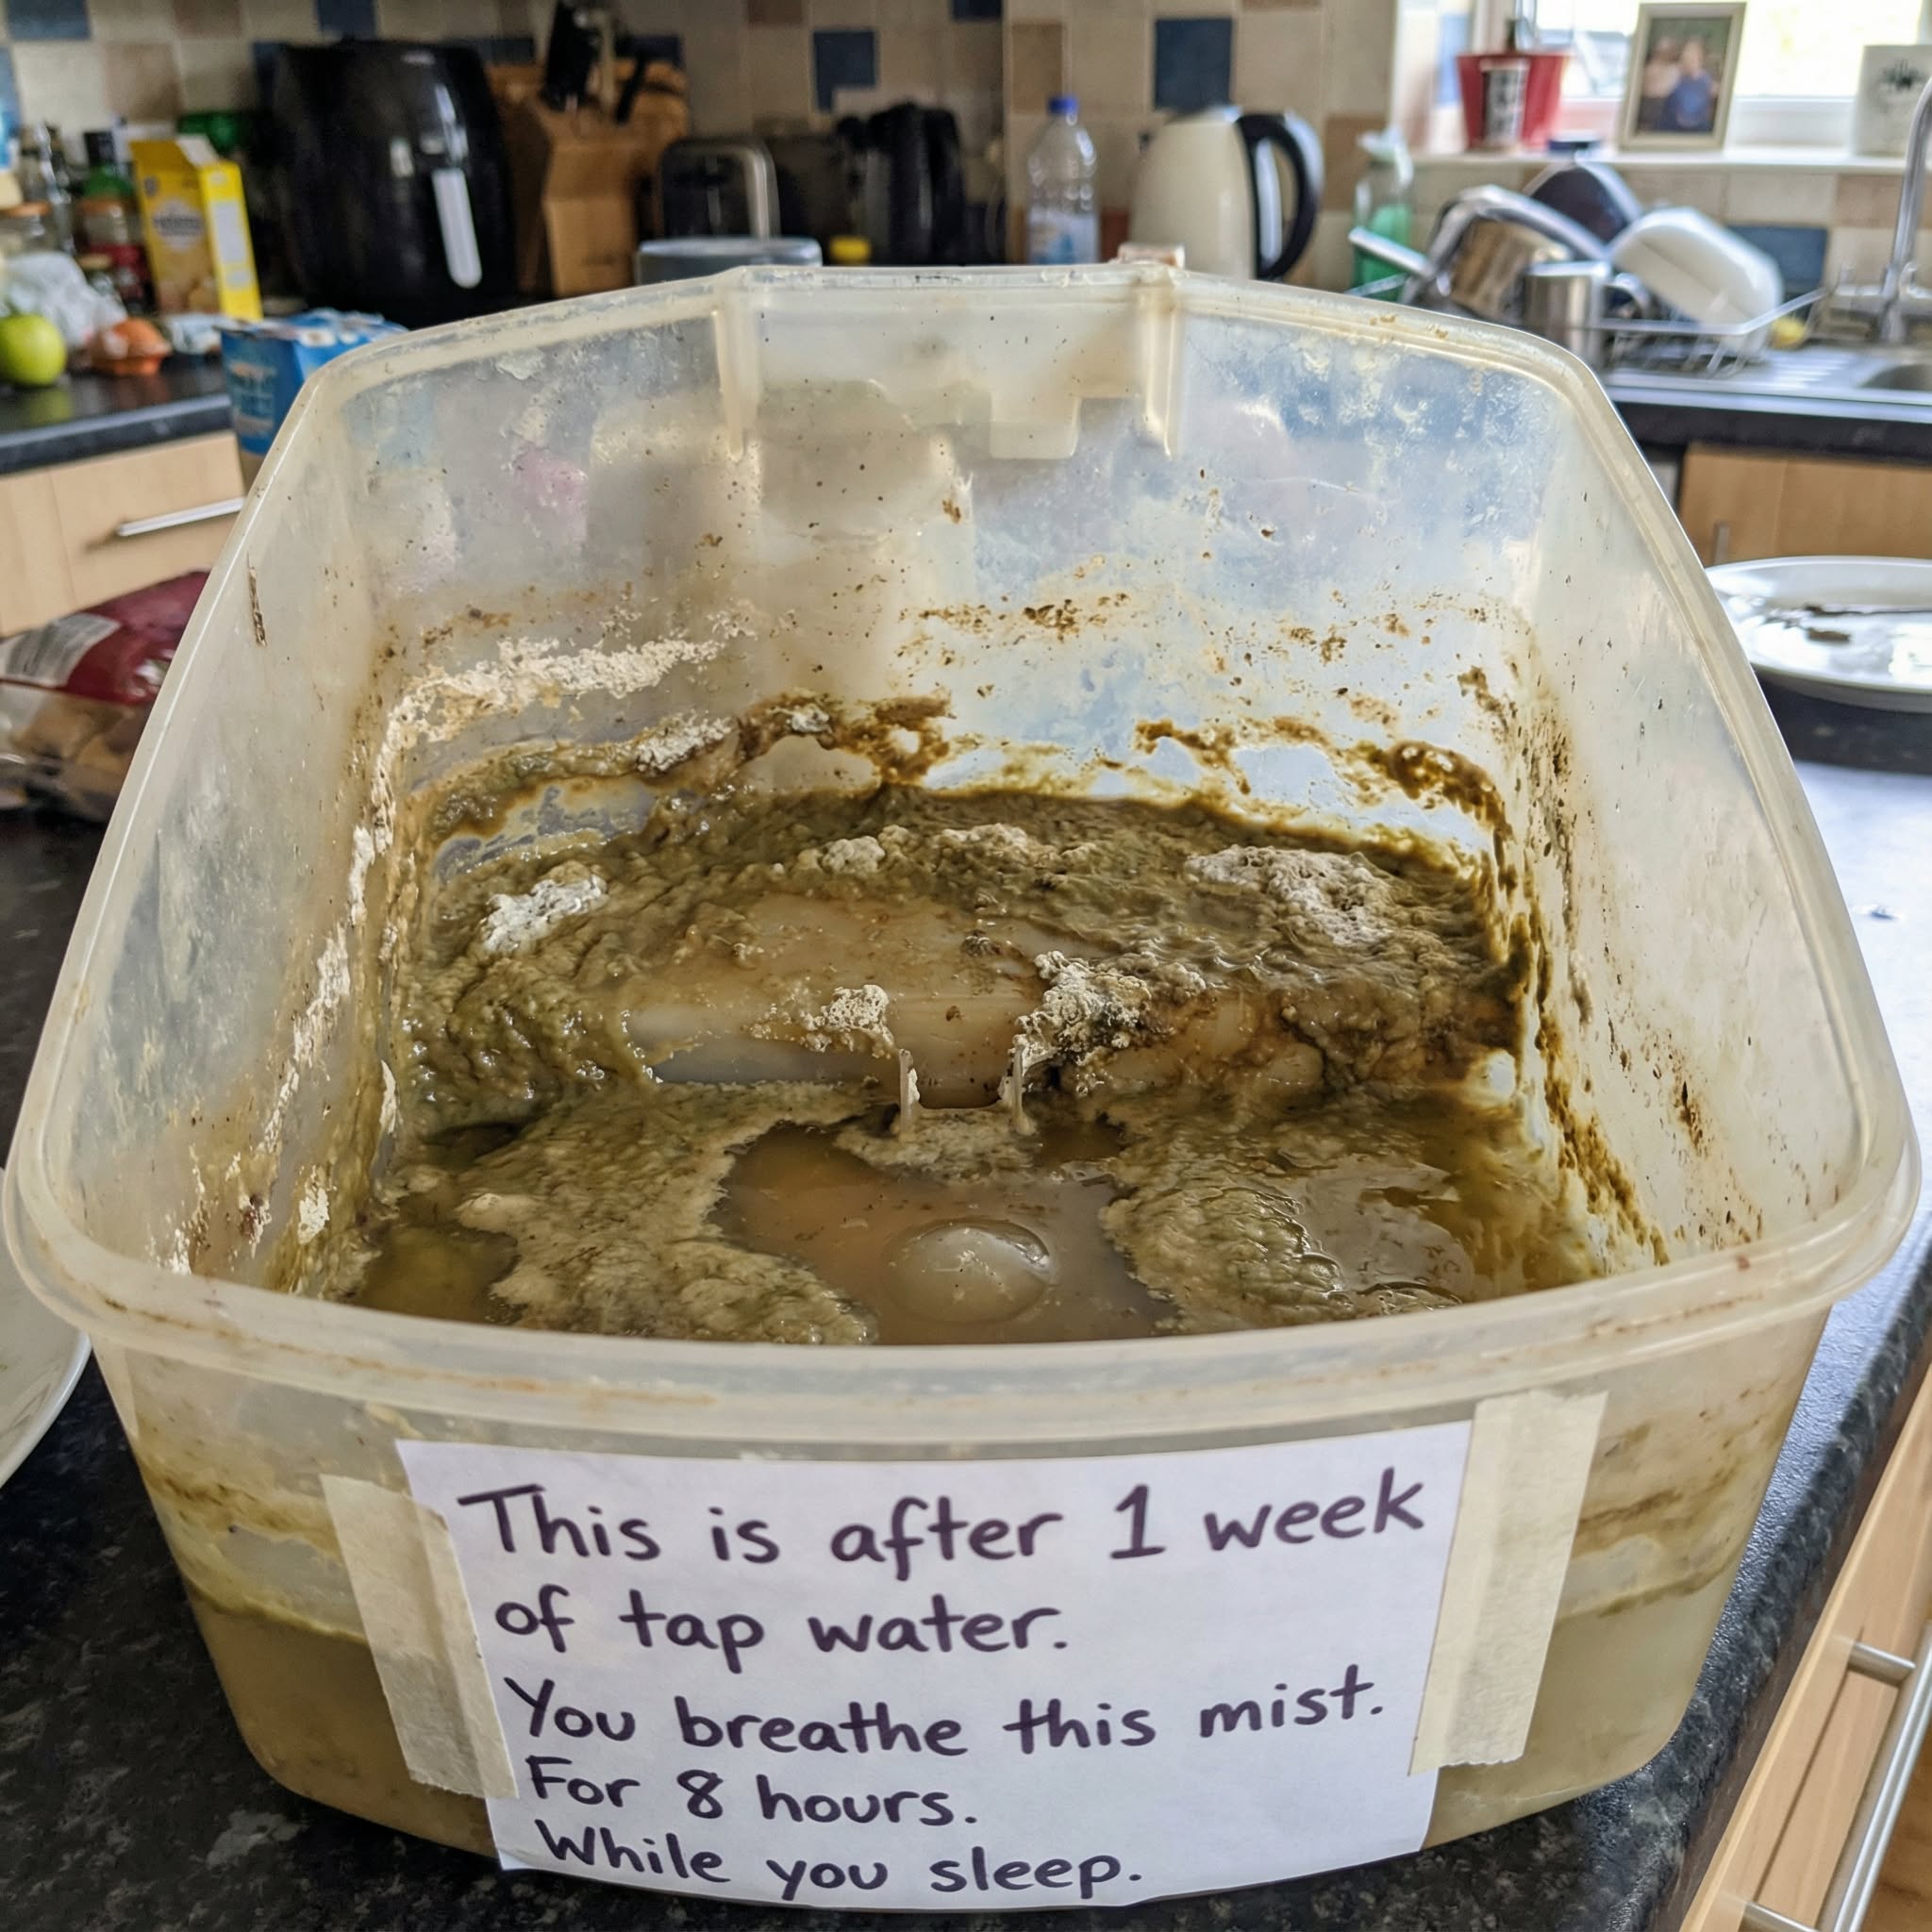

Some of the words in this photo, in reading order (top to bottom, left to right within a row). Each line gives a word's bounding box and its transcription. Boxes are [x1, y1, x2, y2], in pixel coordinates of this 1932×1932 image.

[457, 1484, 660, 1561] This
[709, 1507, 779, 1564] is
[830, 1496, 1062, 1582] after
[1111, 1485, 1165, 1559] 1
[1205, 1468, 1424, 1551] week
[494, 1584, 575, 1654] of
[618, 1589, 765, 1674] tap
[808, 1594, 1067, 1653] water.
[503, 1676, 636, 1741] You
[674, 1695, 968, 1757] breathe
[1002, 1698, 1156, 1755] this
[1200, 1664, 1383, 1738] mist.
[525, 1755, 641, 1808] For
[676, 1769, 724, 1820] 8
[756, 1774, 977, 1826] hours.
[534, 1818, 731, 1883] While
[765, 1859, 888, 1902] you
[929, 1846, 1141, 1900] sleep.
